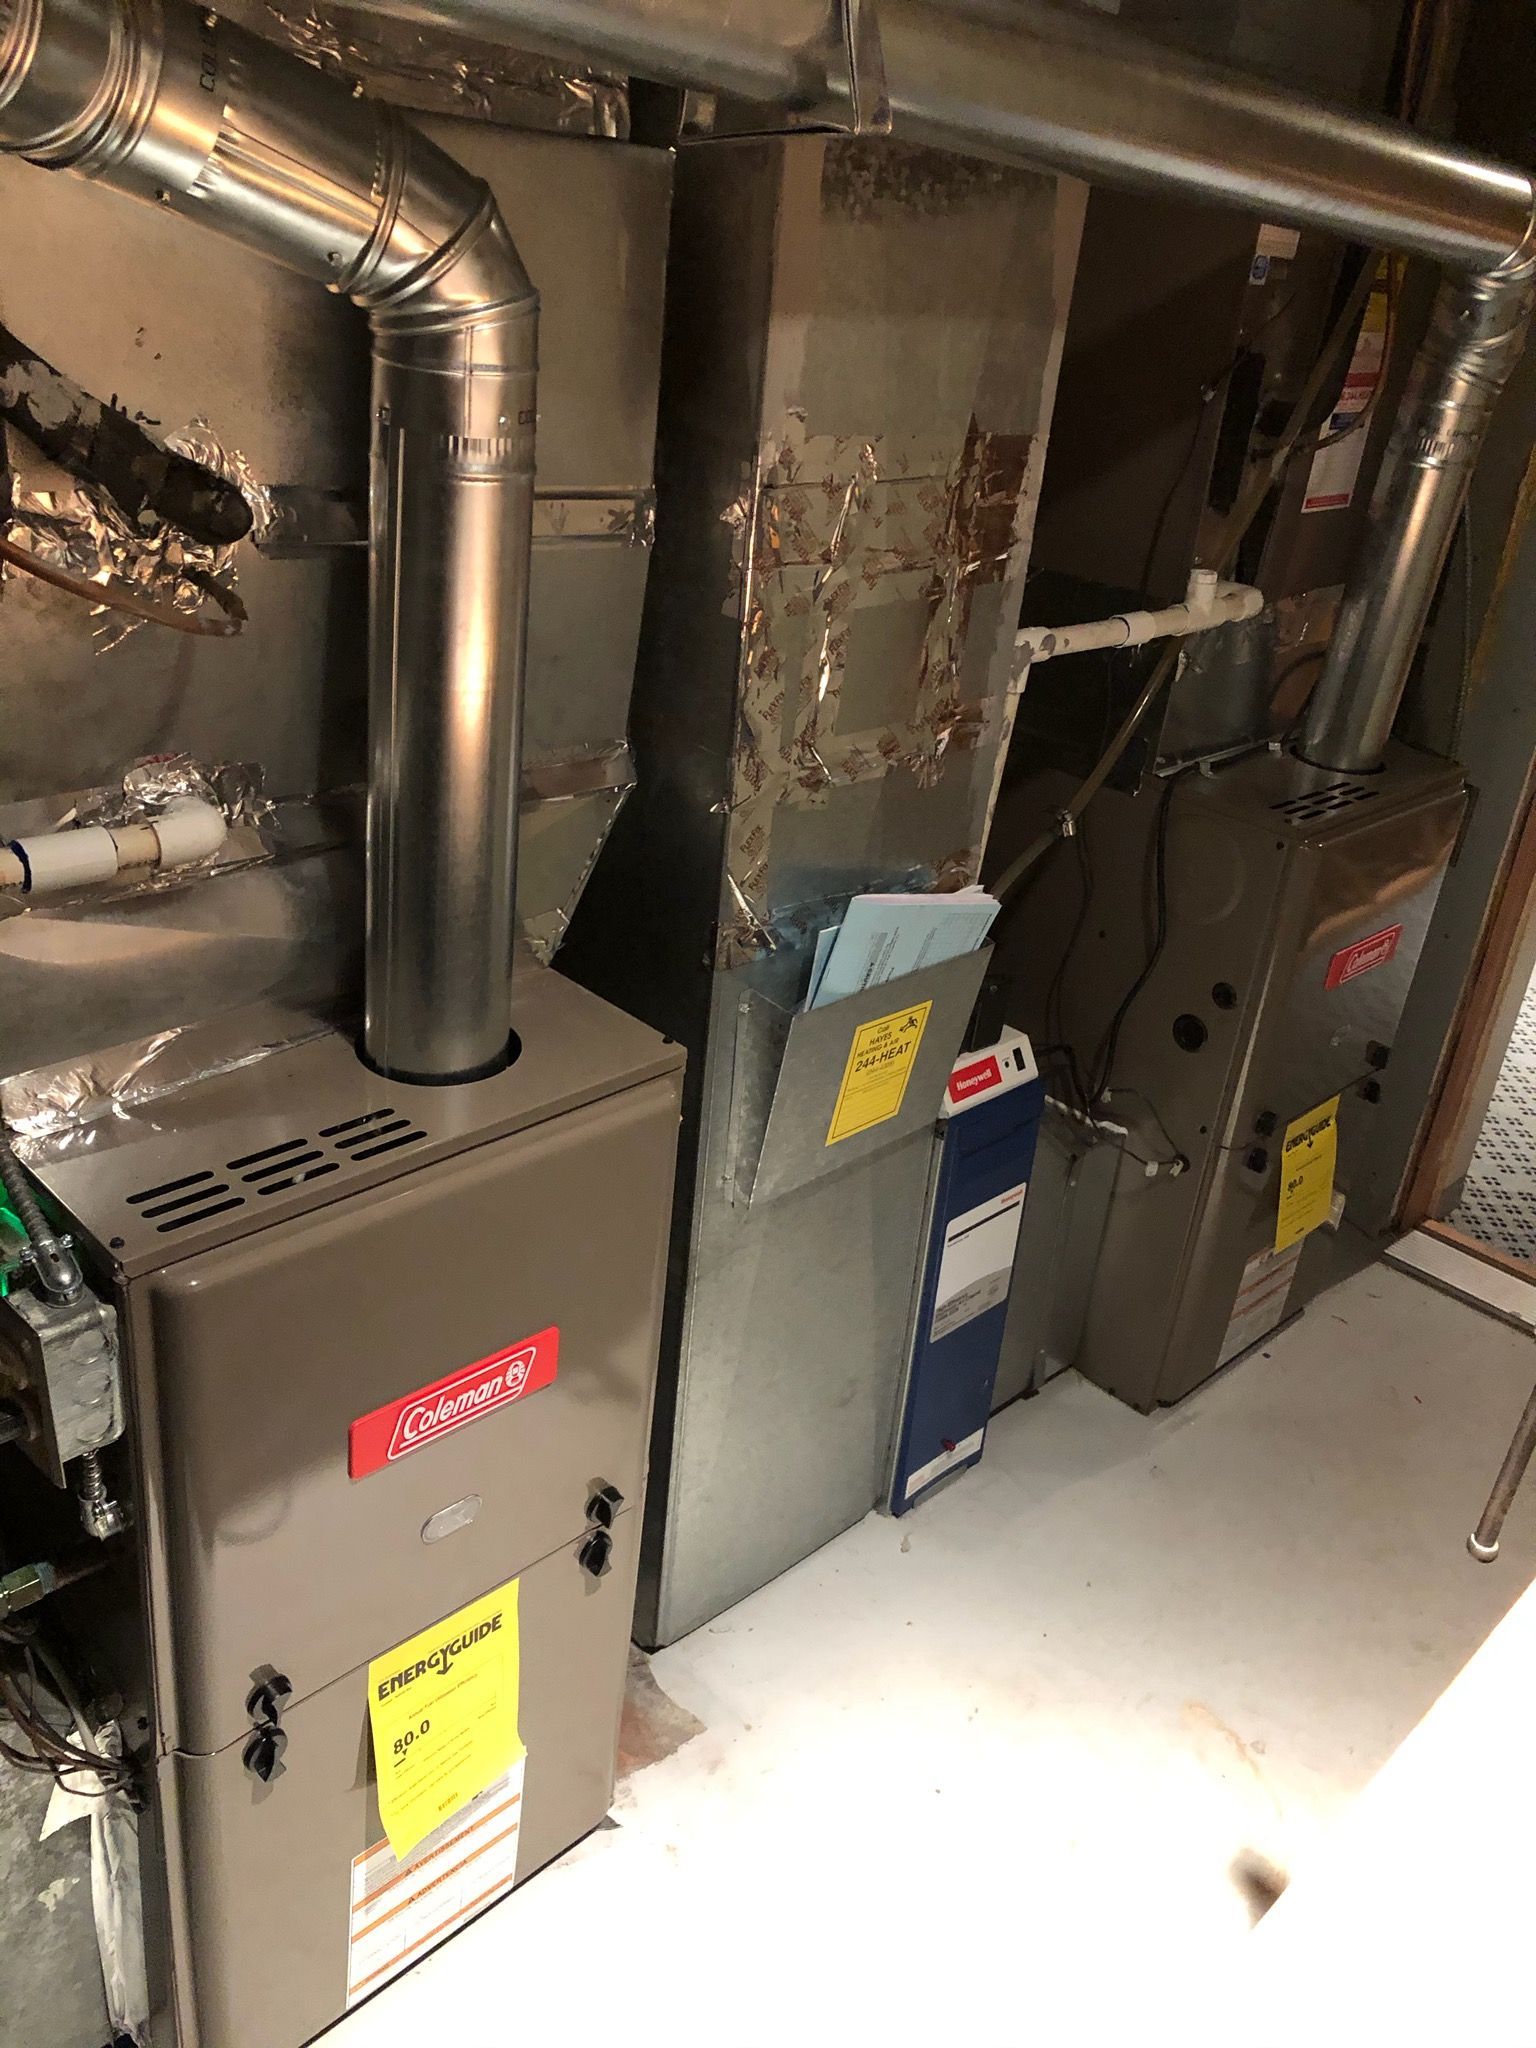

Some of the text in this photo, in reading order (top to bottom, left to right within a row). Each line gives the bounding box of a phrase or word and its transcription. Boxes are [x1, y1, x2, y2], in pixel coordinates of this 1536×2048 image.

[857, 1044, 883, 1058] HEATING
[869, 1032, 893, 1046] HAYES
[855, 1041, 912, 1072] 244-HEAT
[956, 1068, 993, 1091] Honeywell
[403, 1375, 503, 1440] Coleman
[378, 1613, 503, 1701] ENERGYGUIDE
[393, 1719, 431, 1755] 80.0
